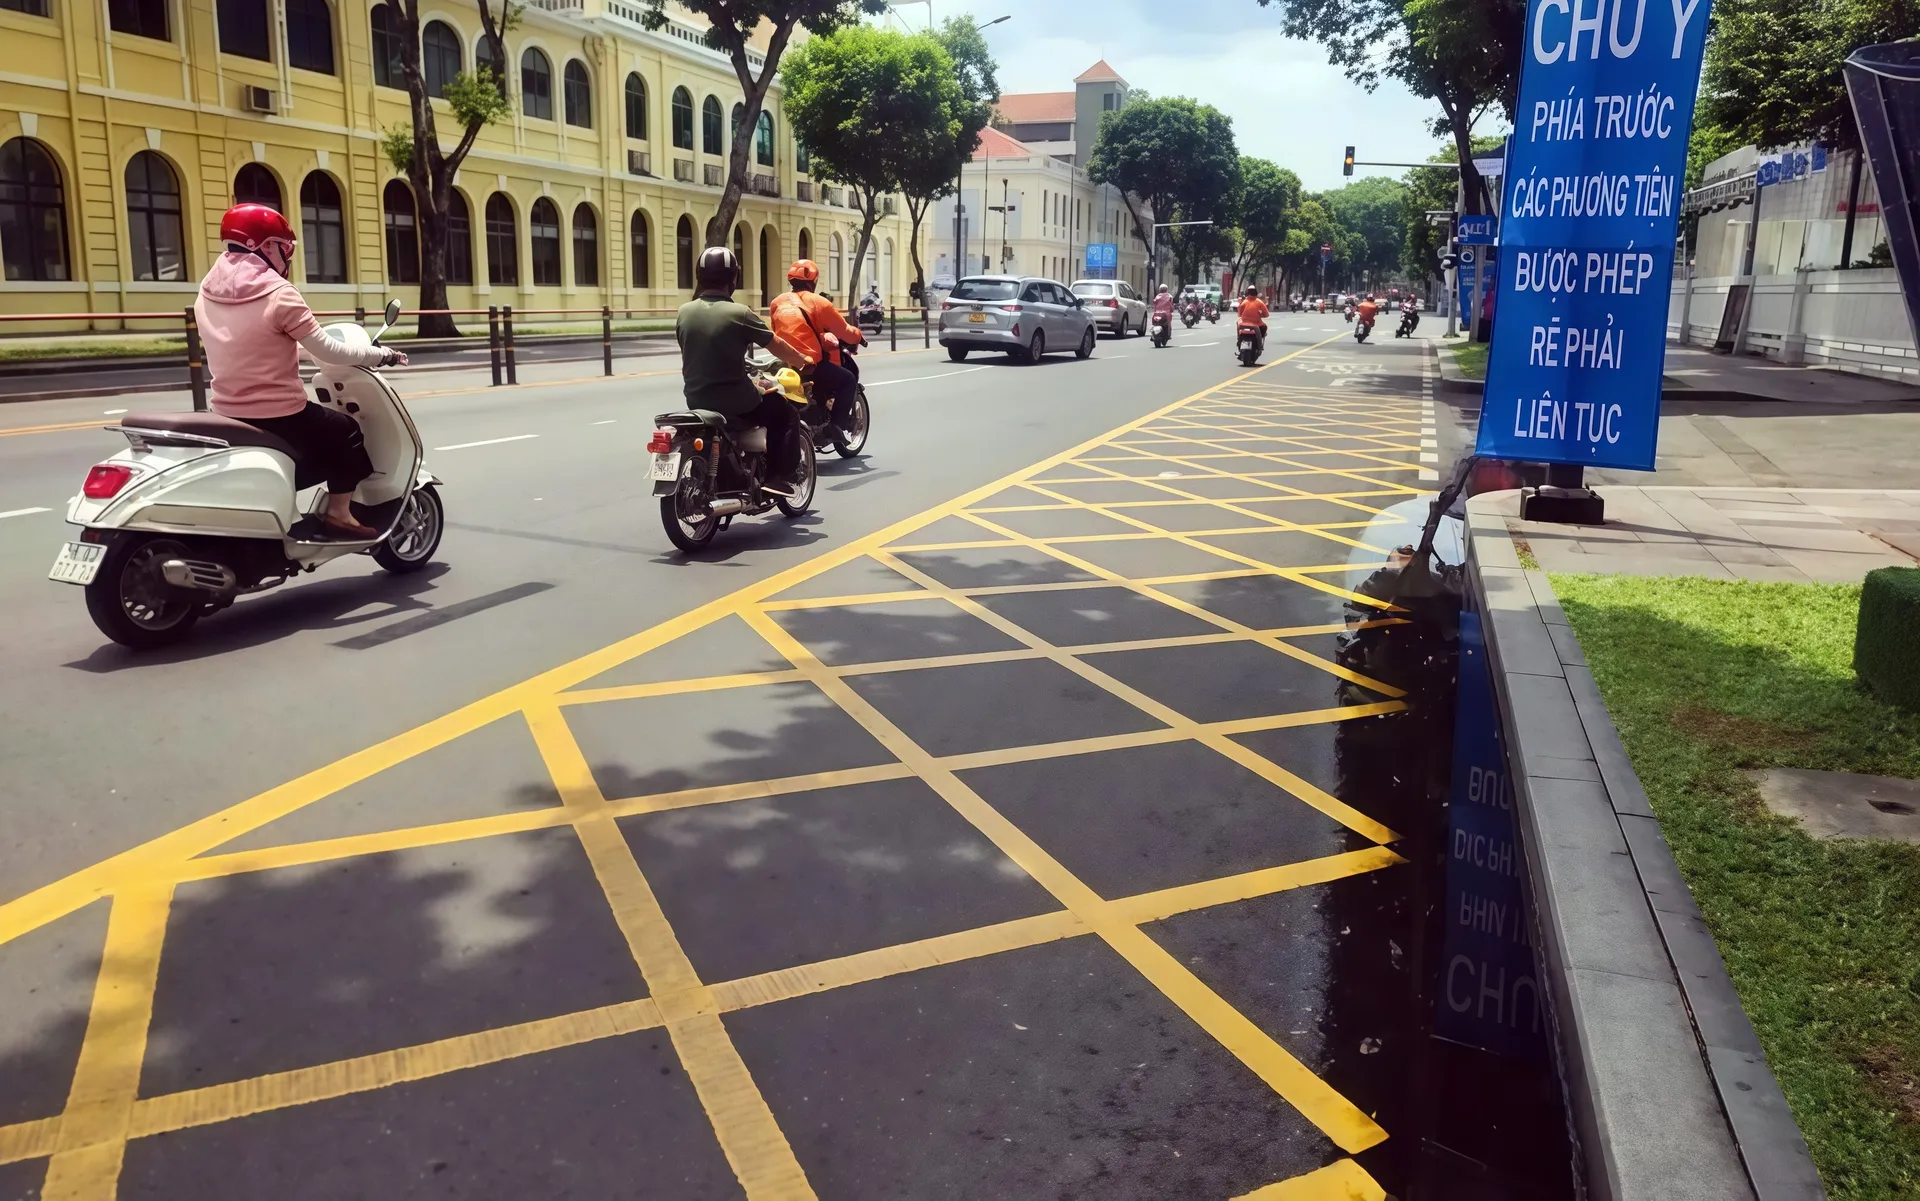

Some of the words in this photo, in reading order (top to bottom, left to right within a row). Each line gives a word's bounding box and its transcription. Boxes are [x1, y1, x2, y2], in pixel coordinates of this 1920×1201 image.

[1531, 85, 1583, 142] PHÍA
[1594, 82, 1675, 139] TRƯỚC
[1512, 165, 1549, 218] CÁC
[1634, 165, 1675, 227] TIỆN
[1584, 240, 1654, 295] PHÉP
[1564, 313, 1624, 369] PHẢI
[1514, 390, 1568, 440] LIÊN
[1574, 402, 1622, 457] TỤC
